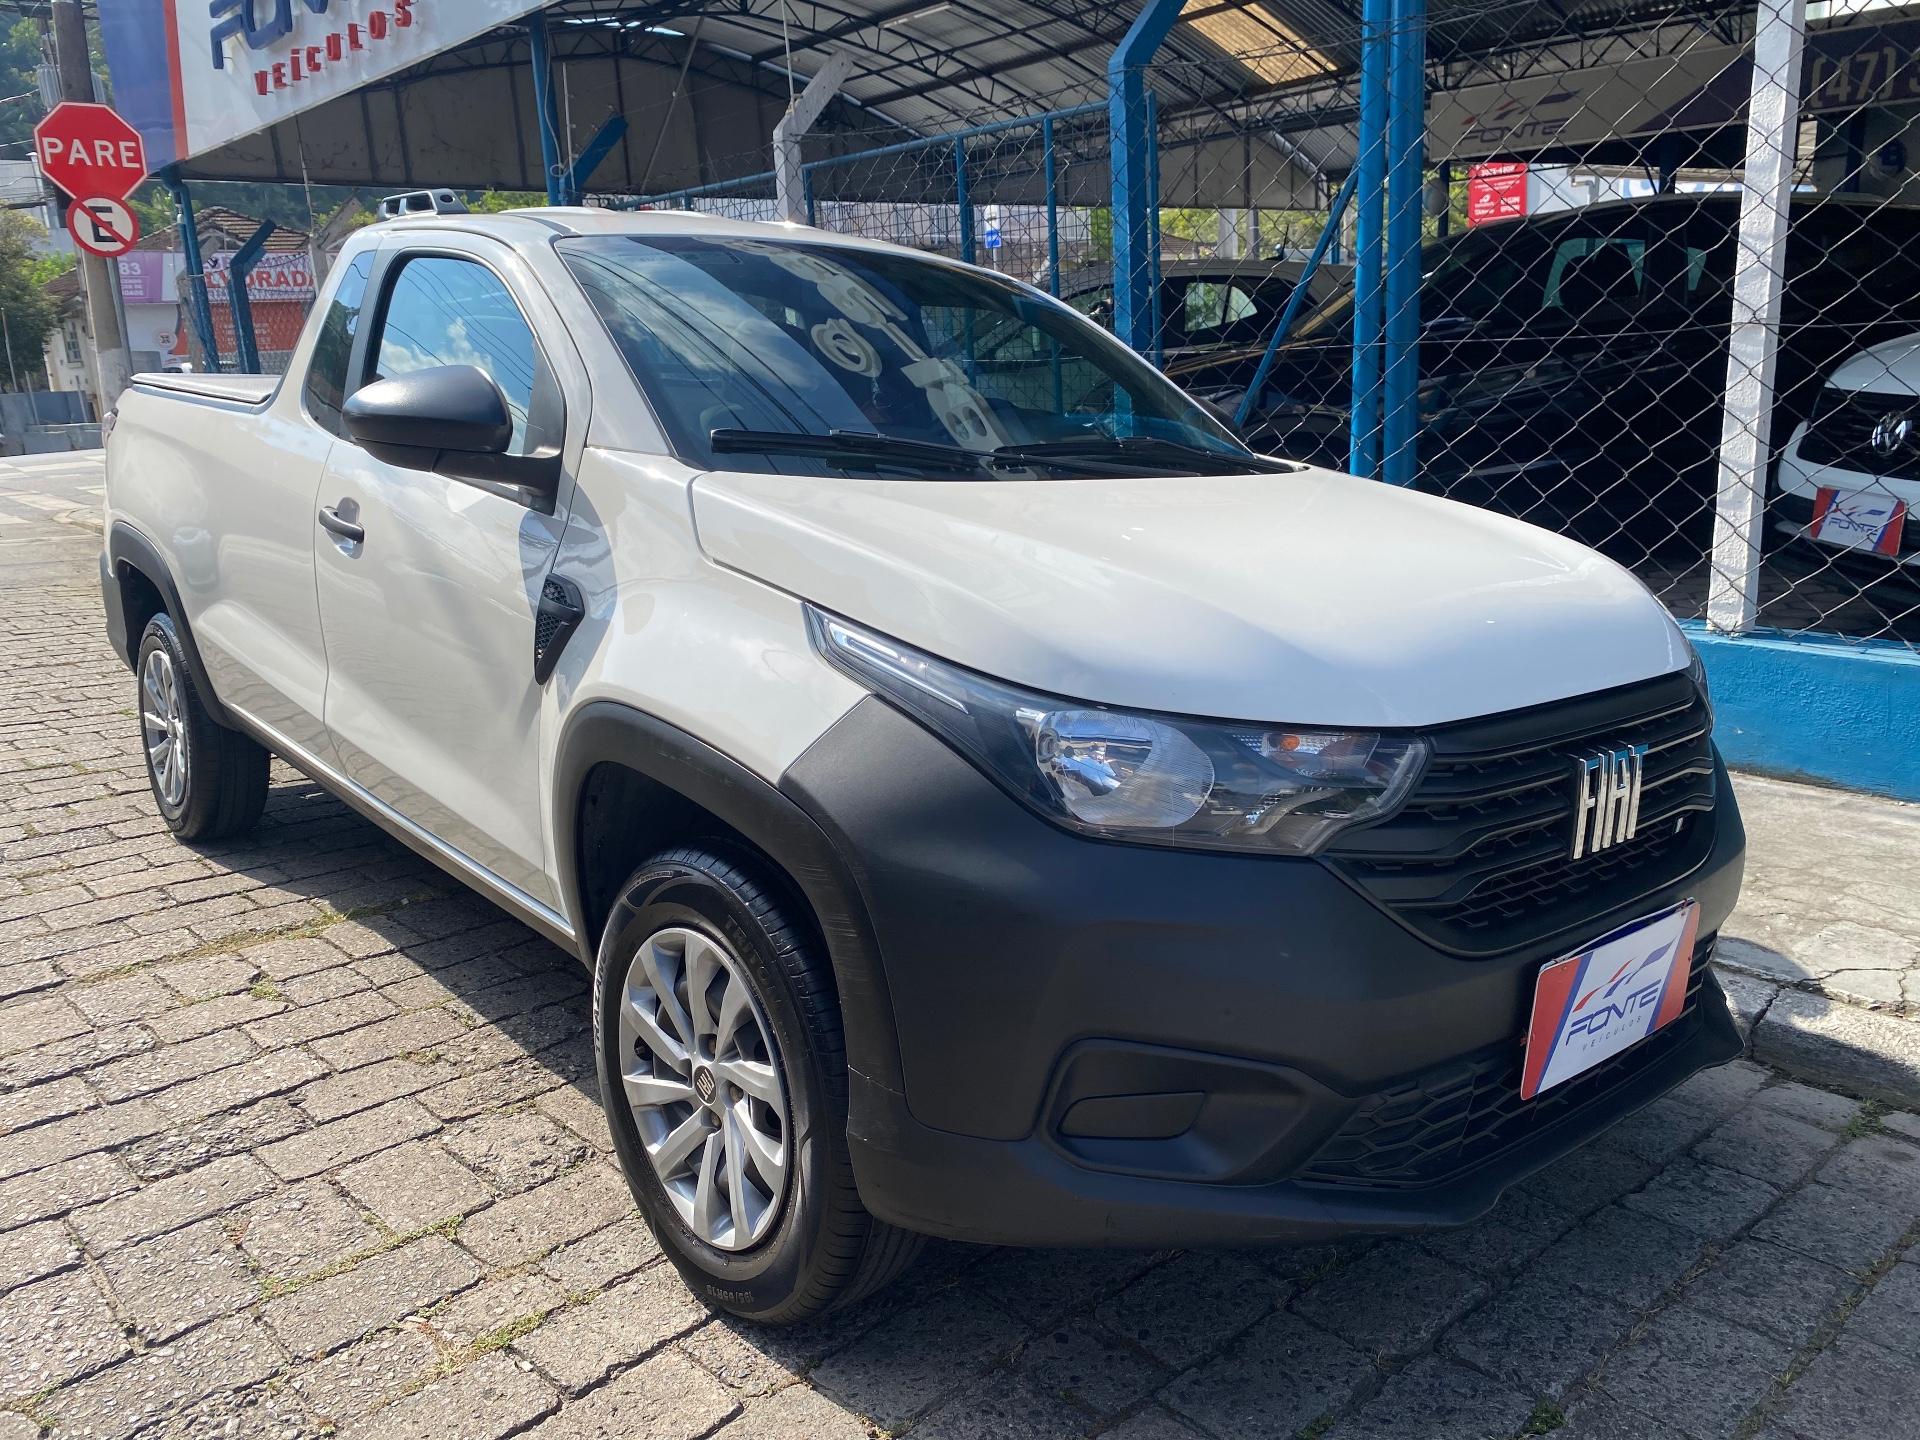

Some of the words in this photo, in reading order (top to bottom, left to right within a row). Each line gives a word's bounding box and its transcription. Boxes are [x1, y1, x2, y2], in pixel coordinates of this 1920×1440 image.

[1458, 117, 1570, 146] FONTE
[42, 137, 140, 168] PARE
[88, 206, 117, 242] E
[1573, 744, 1648, 859] FIAT
[1566, 979, 1661, 1046] FONTE
